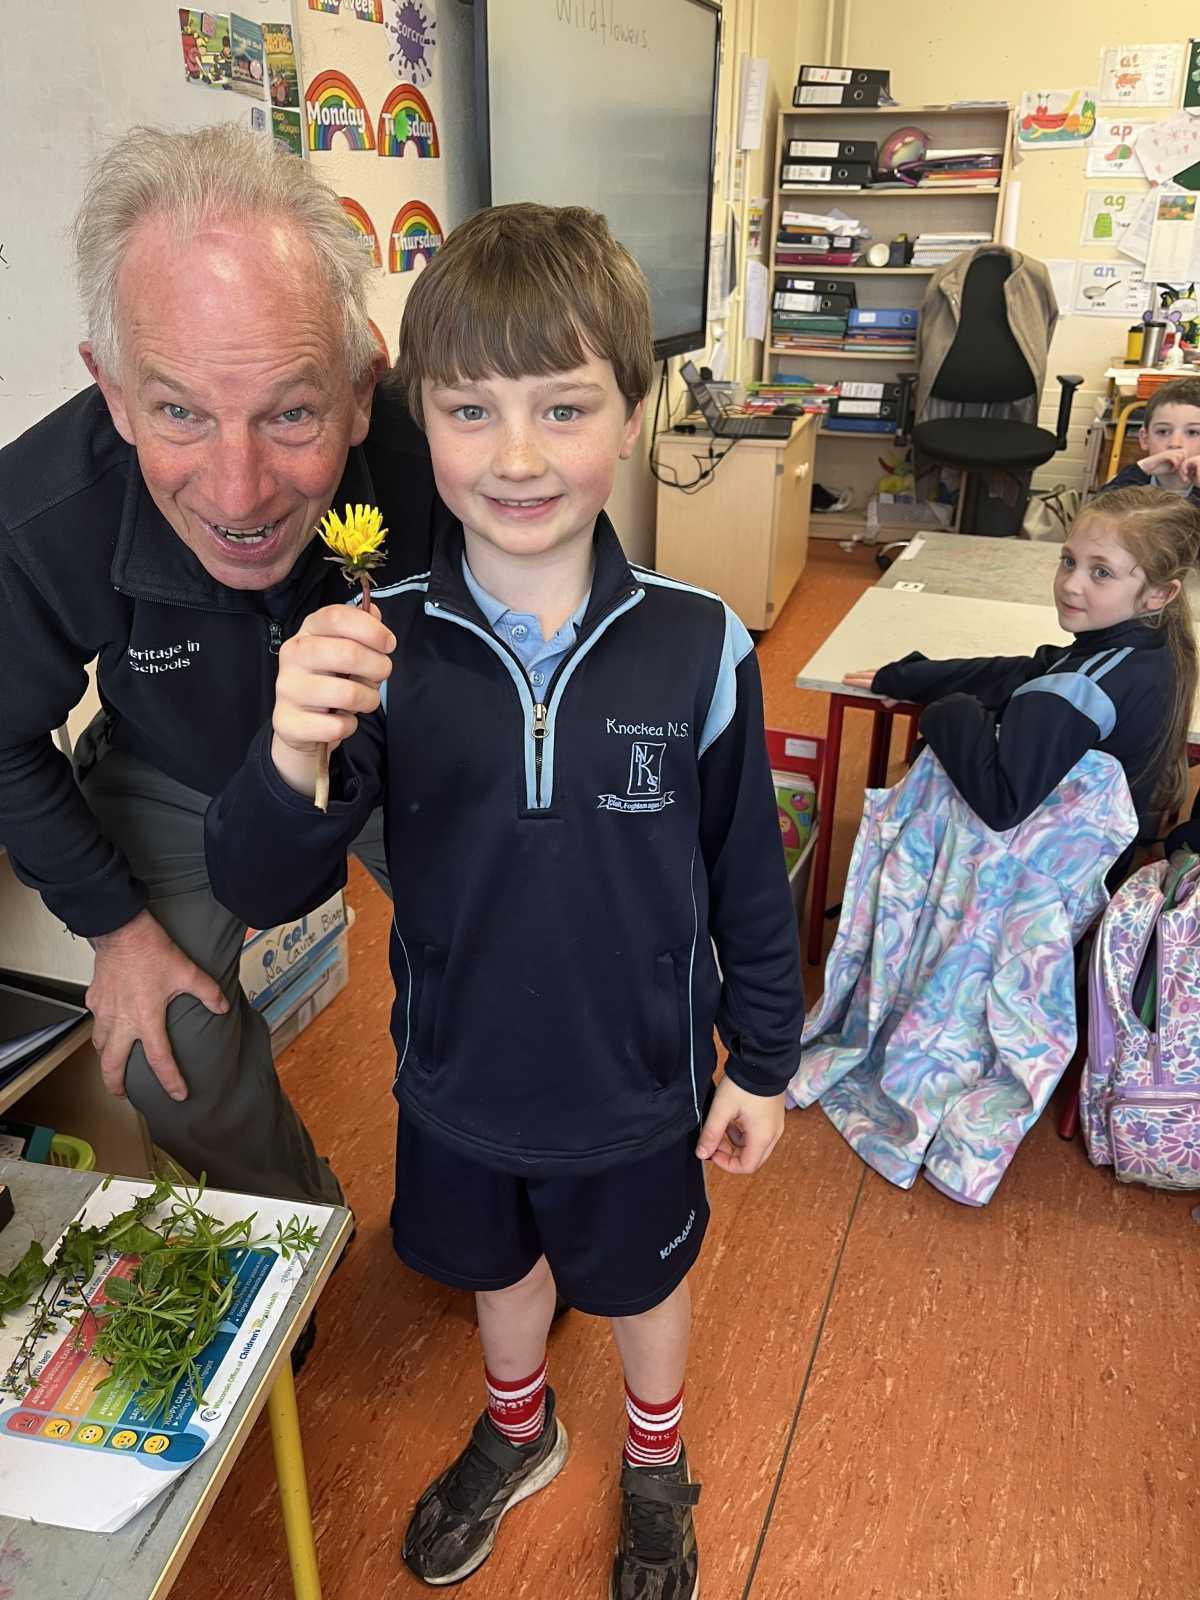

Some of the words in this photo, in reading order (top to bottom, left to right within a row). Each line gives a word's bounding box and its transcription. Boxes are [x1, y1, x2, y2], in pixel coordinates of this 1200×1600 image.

[1120, 54, 1140, 68] at
[306, 100, 365, 133] Monday
[382, 112, 433, 144] Tsday
[1110, 125, 1132, 142] ap
[1103, 195, 1126, 212] ag
[1093, 265, 1116, 278] an
[128, 644, 182, 661] eritage
[187, 640, 200, 652] in
[129, 658, 191, 674] Schools
[606, 718, 664, 736] Knockea
[239, 1328, 261, 1360] Children's
